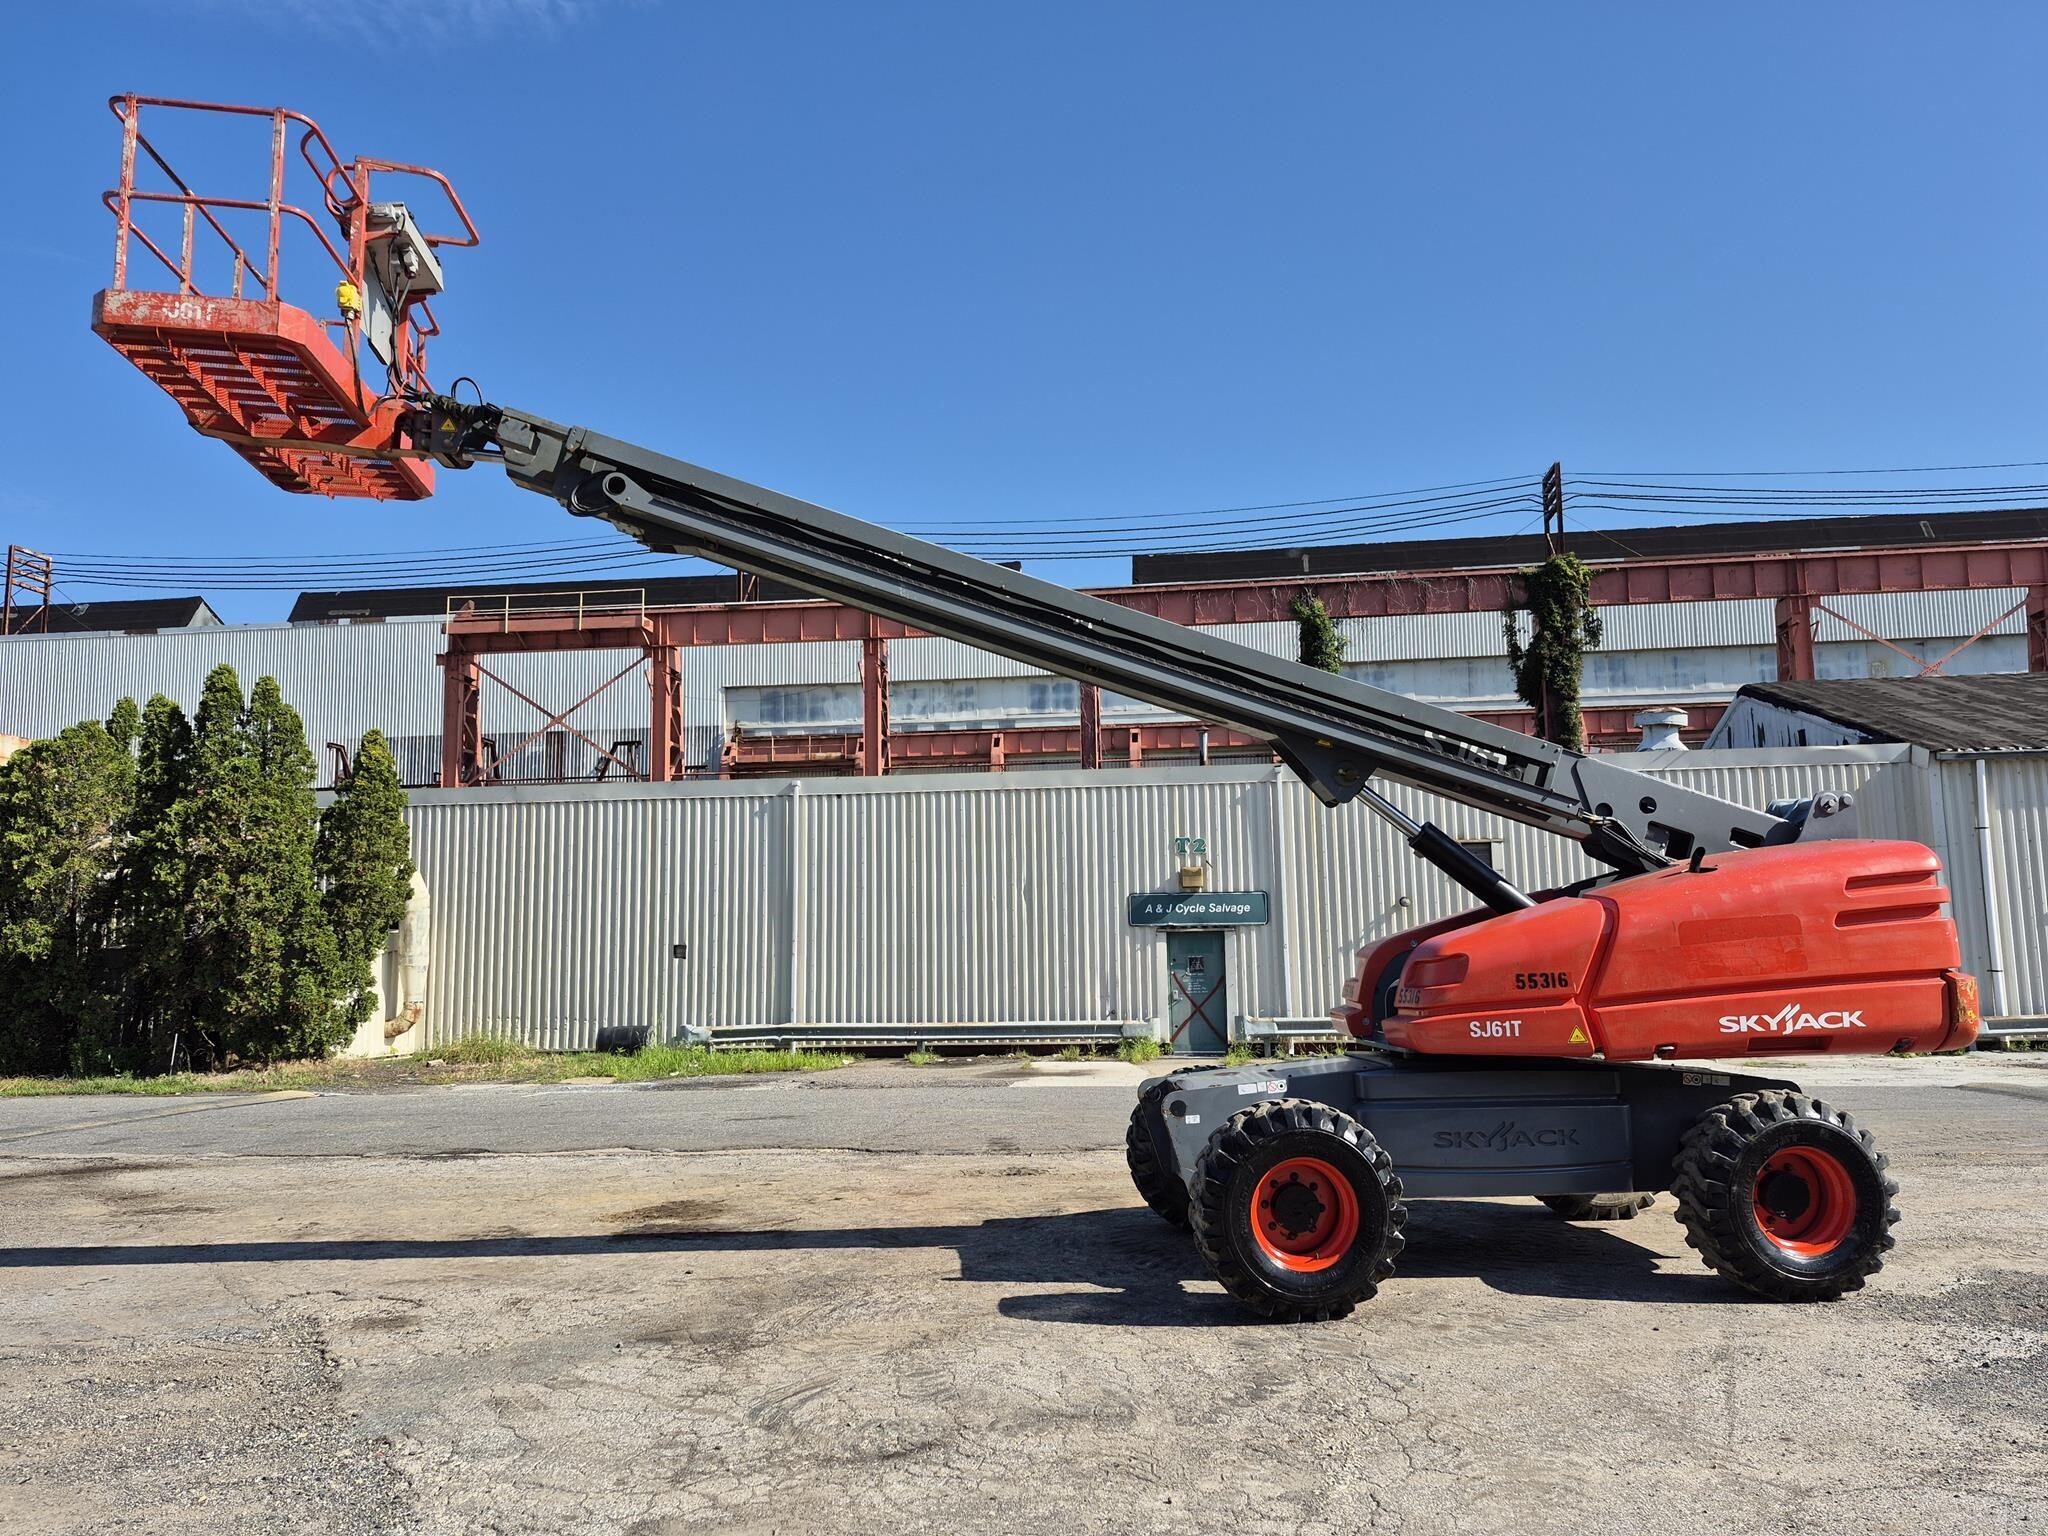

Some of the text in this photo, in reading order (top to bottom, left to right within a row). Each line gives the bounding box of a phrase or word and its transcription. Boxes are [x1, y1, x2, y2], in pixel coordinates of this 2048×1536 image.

[1145, 903, 1251, 915] A & J Cycle Salvage
[1515, 972, 1569, 990] 55316
[1718, 1002, 1867, 1036] SKYJACK
[1469, 1020, 1522, 1038] SJ61T
[1432, 1120, 1580, 1152] SKYJACK
